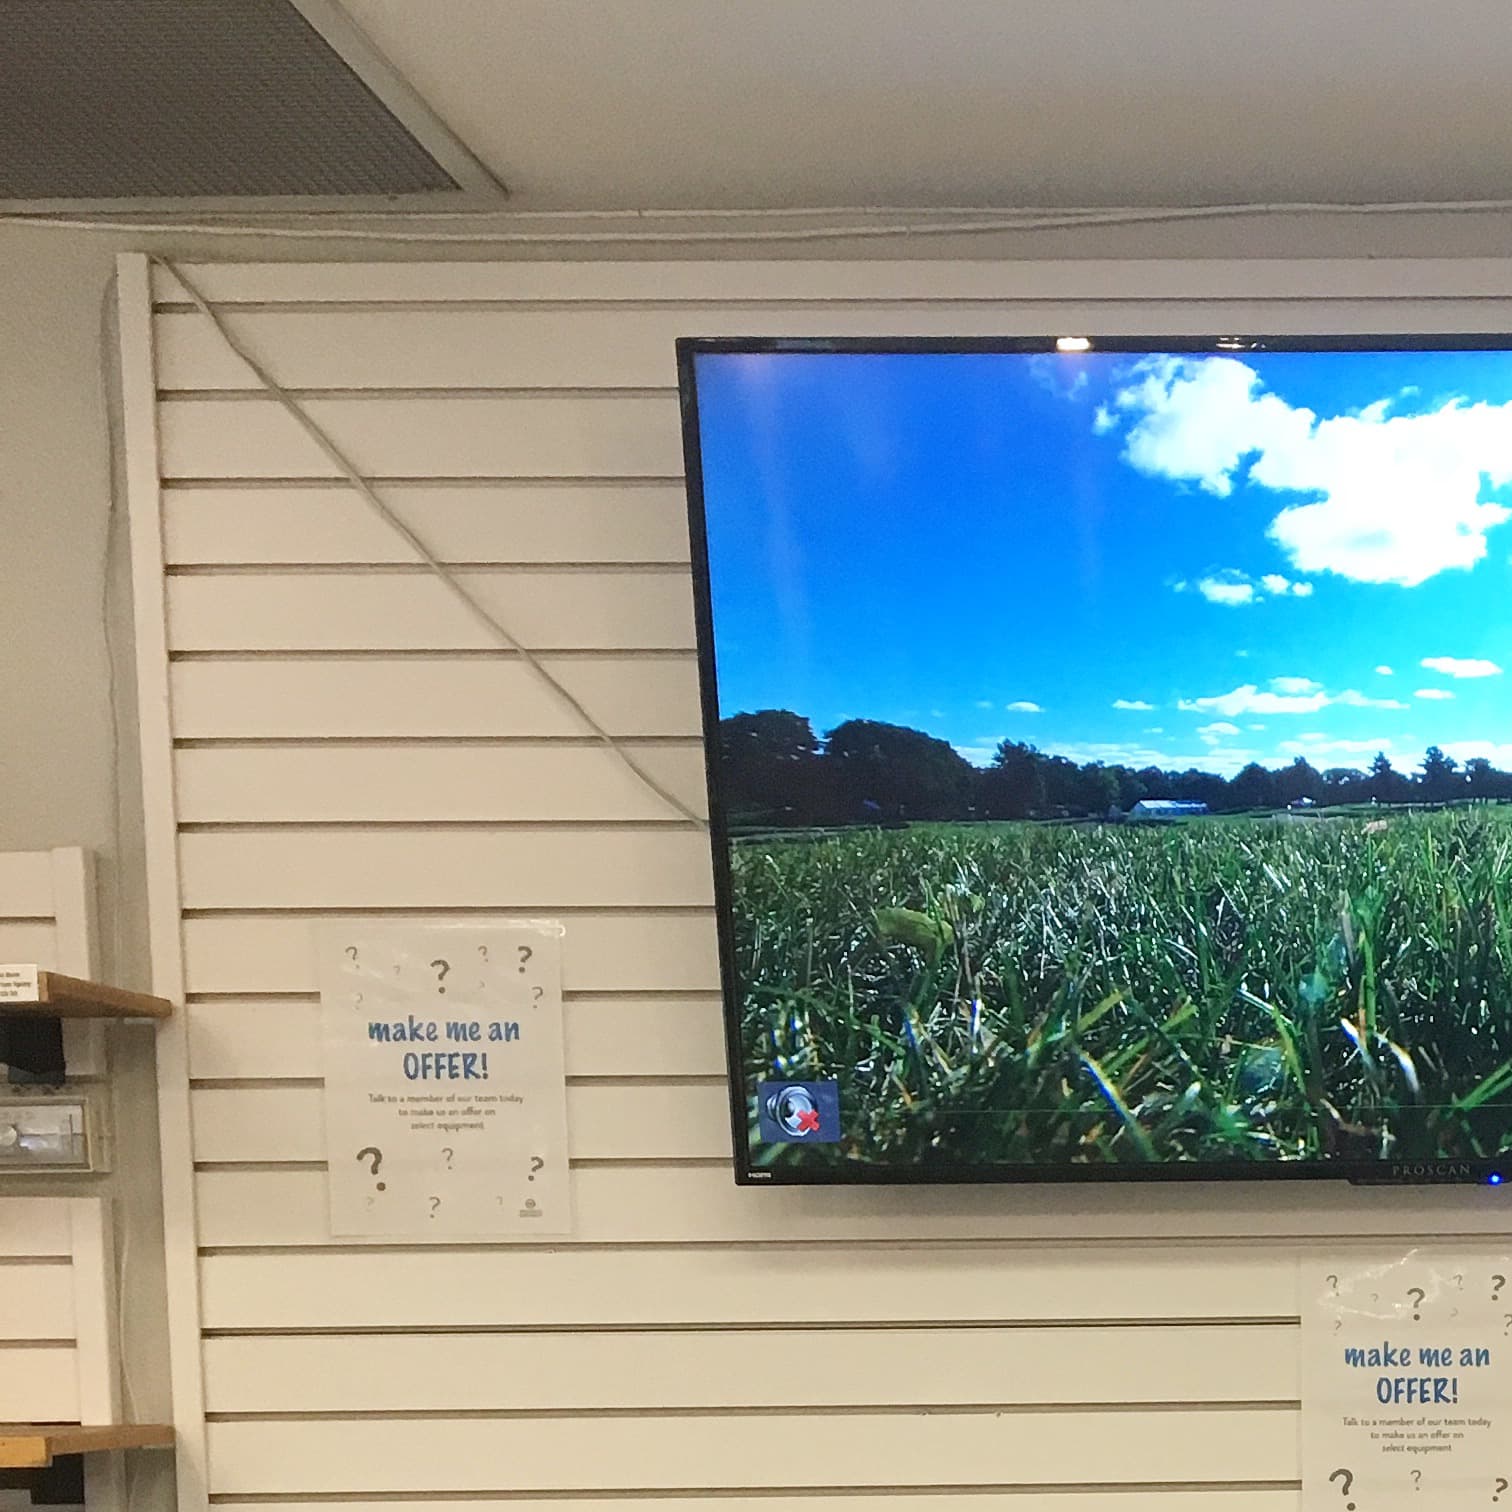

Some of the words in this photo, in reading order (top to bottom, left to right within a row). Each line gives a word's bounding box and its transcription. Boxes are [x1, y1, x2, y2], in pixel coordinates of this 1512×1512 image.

[368, 1015, 438, 1041] make
[446, 1021, 481, 1041] me
[488, 1021, 519, 1041] an
[403, 1052, 488, 1079] OFFER!
[1392, 1164, 1470, 1176] PROSCAN
[1345, 1341, 1411, 1367] make
[1420, 1348, 1452, 1367] me
[1460, 1348, 1490, 1366] an
[1377, 1378, 1458, 1404] OFFER!
